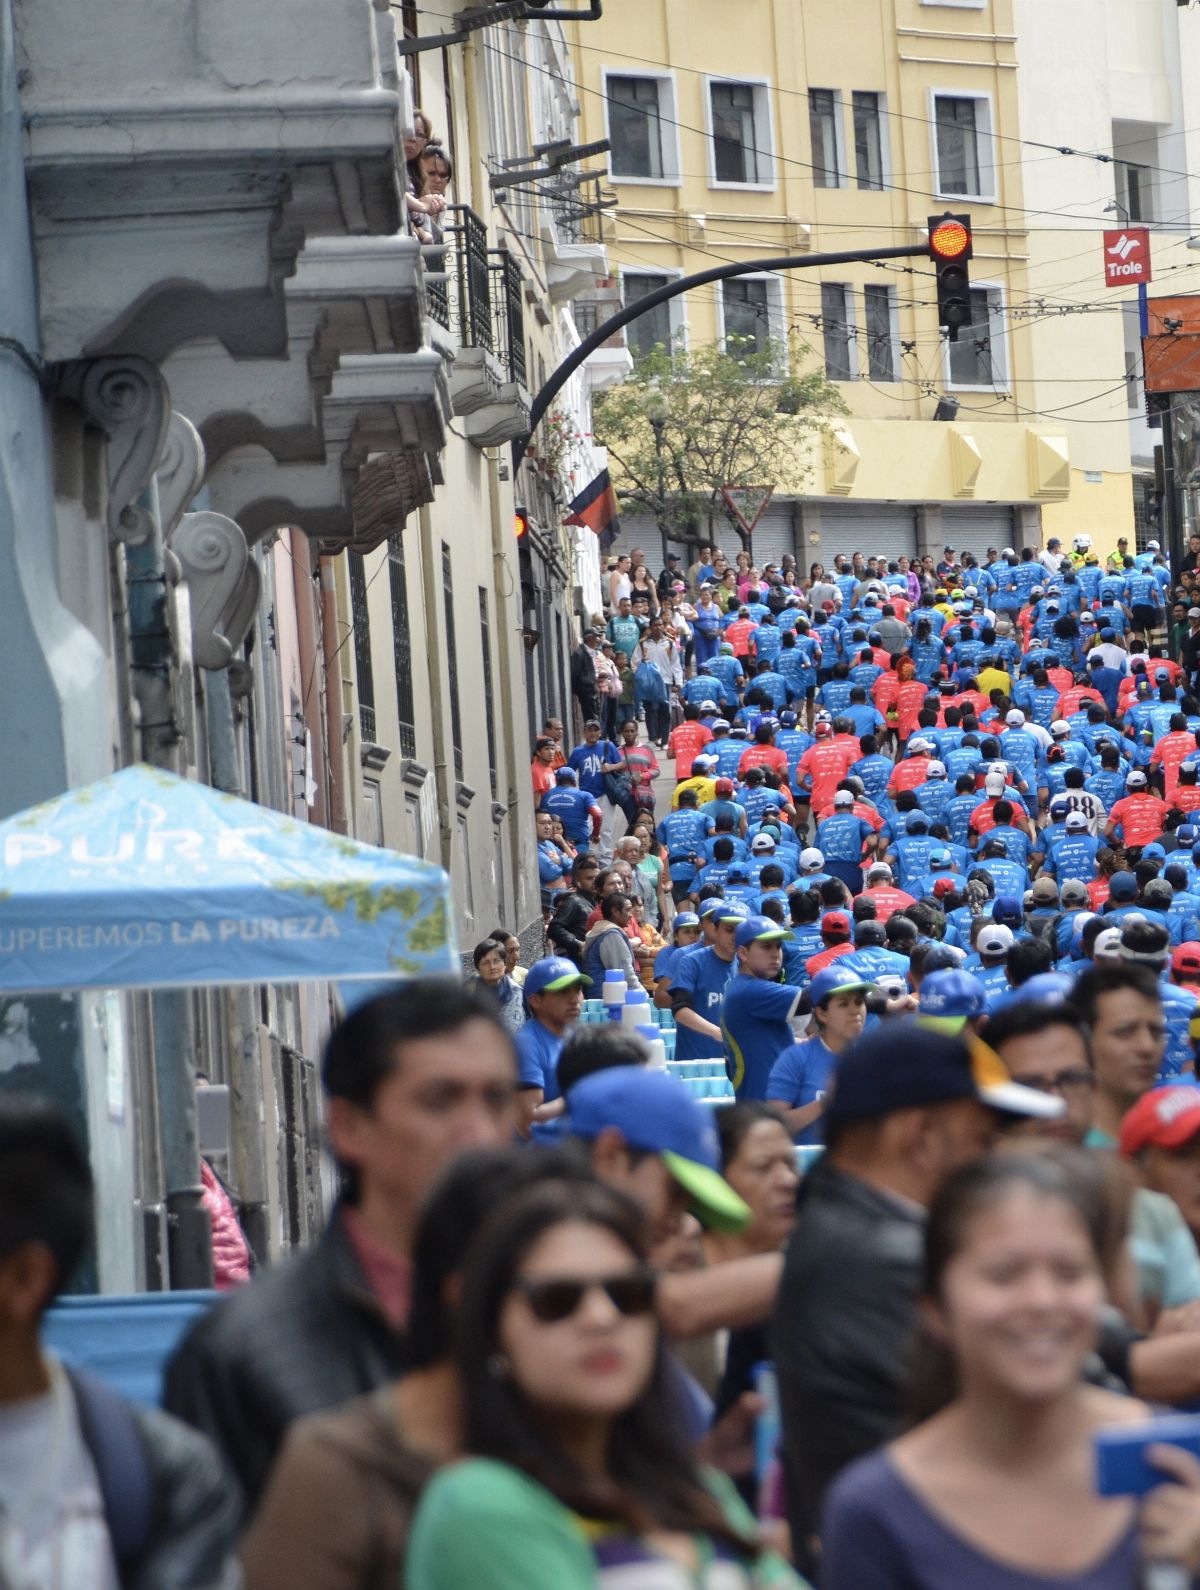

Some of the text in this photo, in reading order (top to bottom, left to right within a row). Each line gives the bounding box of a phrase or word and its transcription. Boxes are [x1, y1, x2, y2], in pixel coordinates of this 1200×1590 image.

[1107, 261, 1142, 277] Trole
[4, 825, 272, 868] PURE
[171, 920, 211, 944] LA
[218, 915, 341, 943] PUREZA
